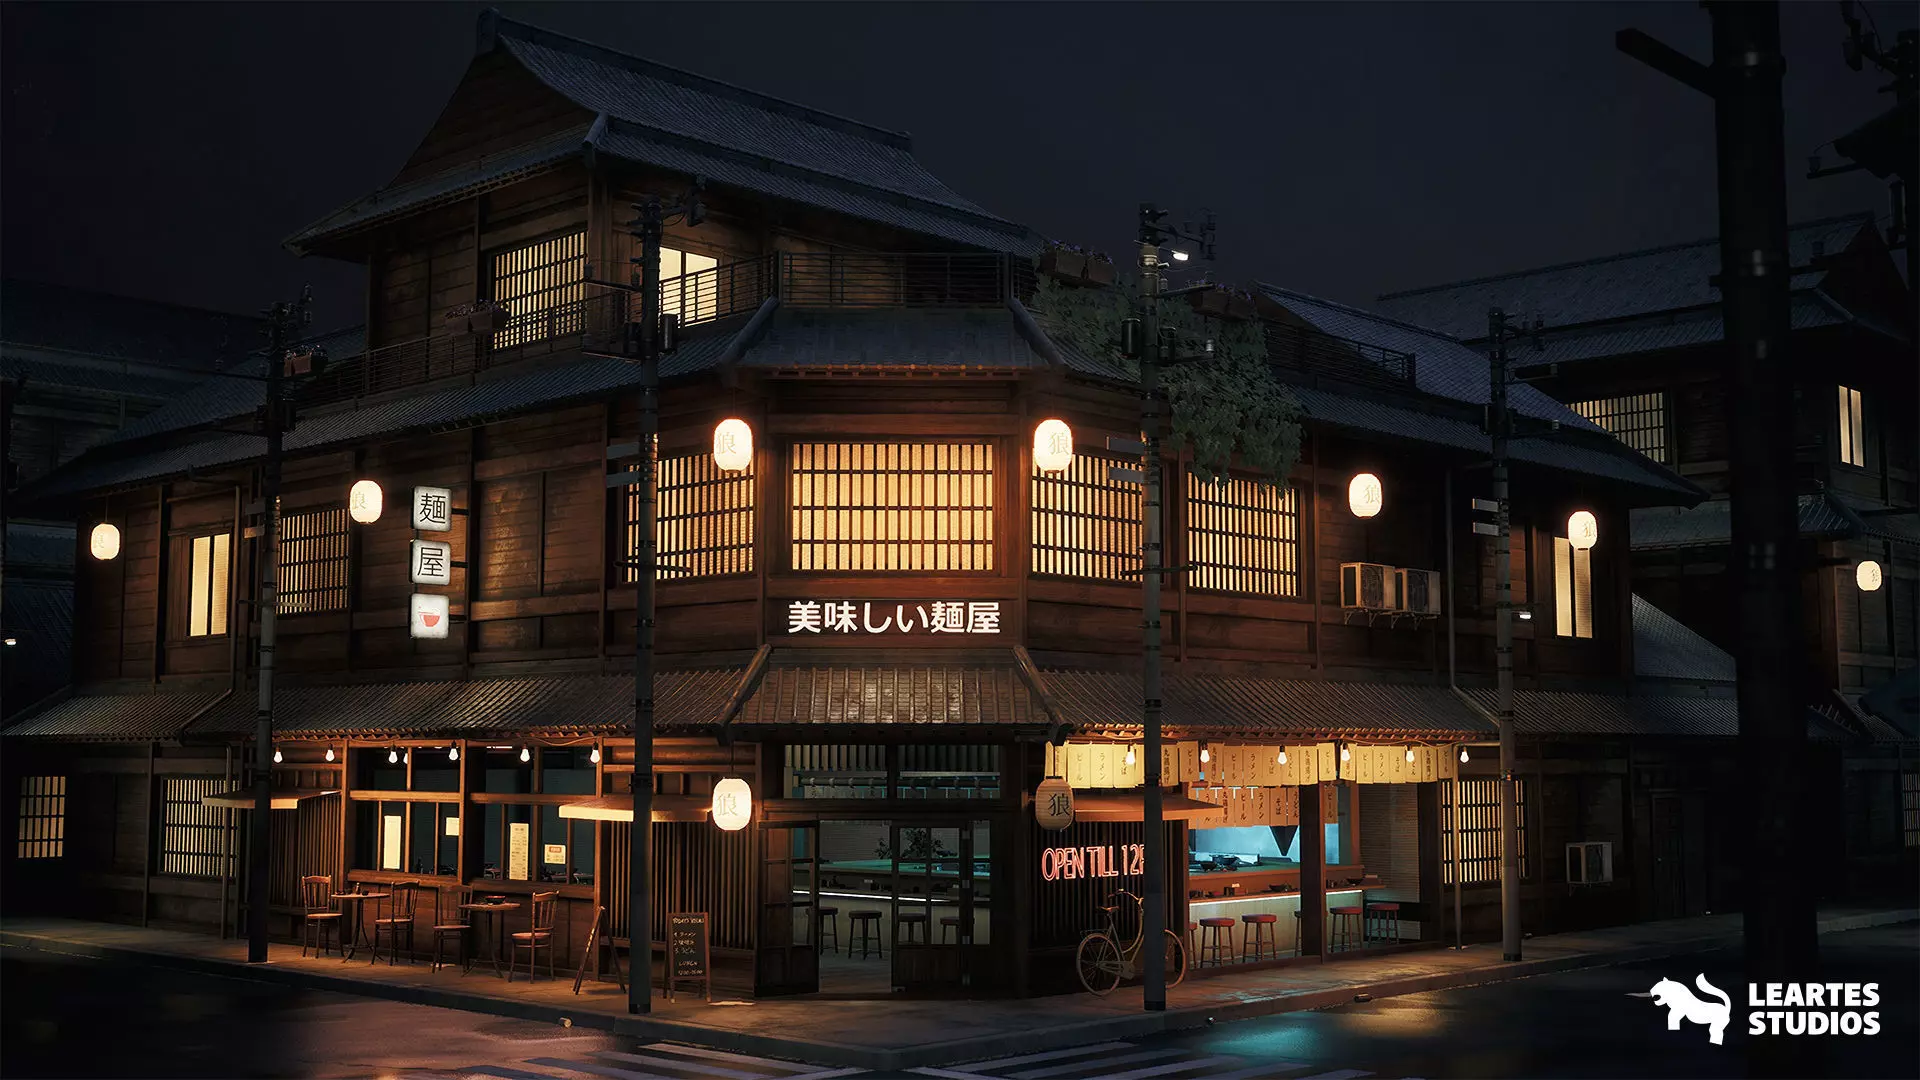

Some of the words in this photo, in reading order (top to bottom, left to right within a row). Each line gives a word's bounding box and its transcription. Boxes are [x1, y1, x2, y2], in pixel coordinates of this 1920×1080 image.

[716, 431, 737, 455] 狼
[1048, 431, 1070, 456] 狼
[788, 600, 1001, 634] 美味しい麺屋
[716, 793, 737, 817] 狼
[1048, 793, 1071, 817] 狼
[1041, 847, 1085, 881] OPEN
[1086, 845, 1119, 877] TILL
